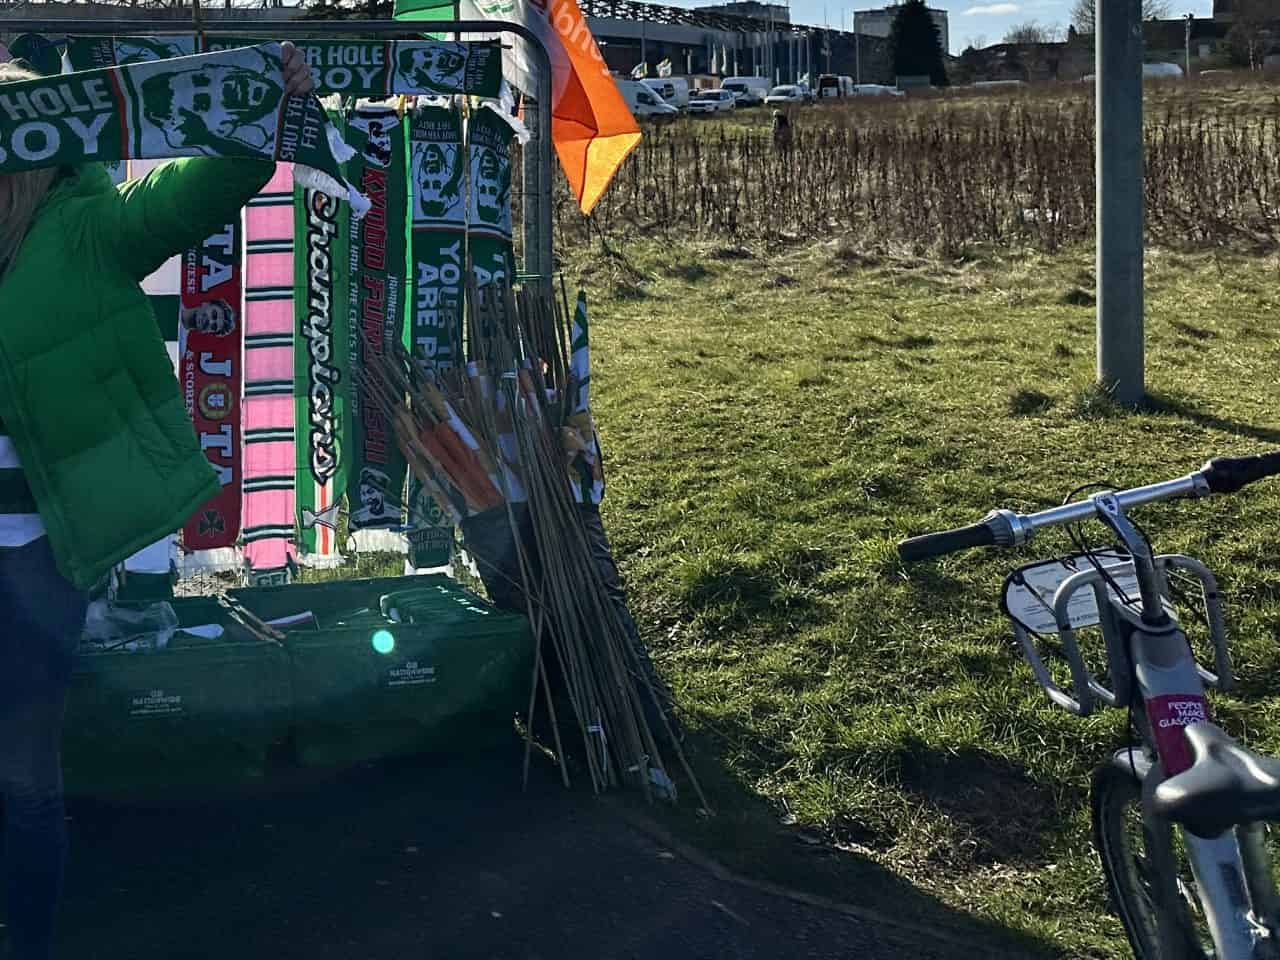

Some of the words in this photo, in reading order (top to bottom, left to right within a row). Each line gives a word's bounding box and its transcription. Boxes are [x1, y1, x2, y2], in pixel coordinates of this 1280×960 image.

[327, 44, 386, 66] HOLE
[279, 120, 300, 161] SHUT
[300, 112, 320, 150] FAT
[361, 166, 388, 270] KYOGO
[416, 261, 439, 327] ARE
[302, 188, 341, 488] Champions
